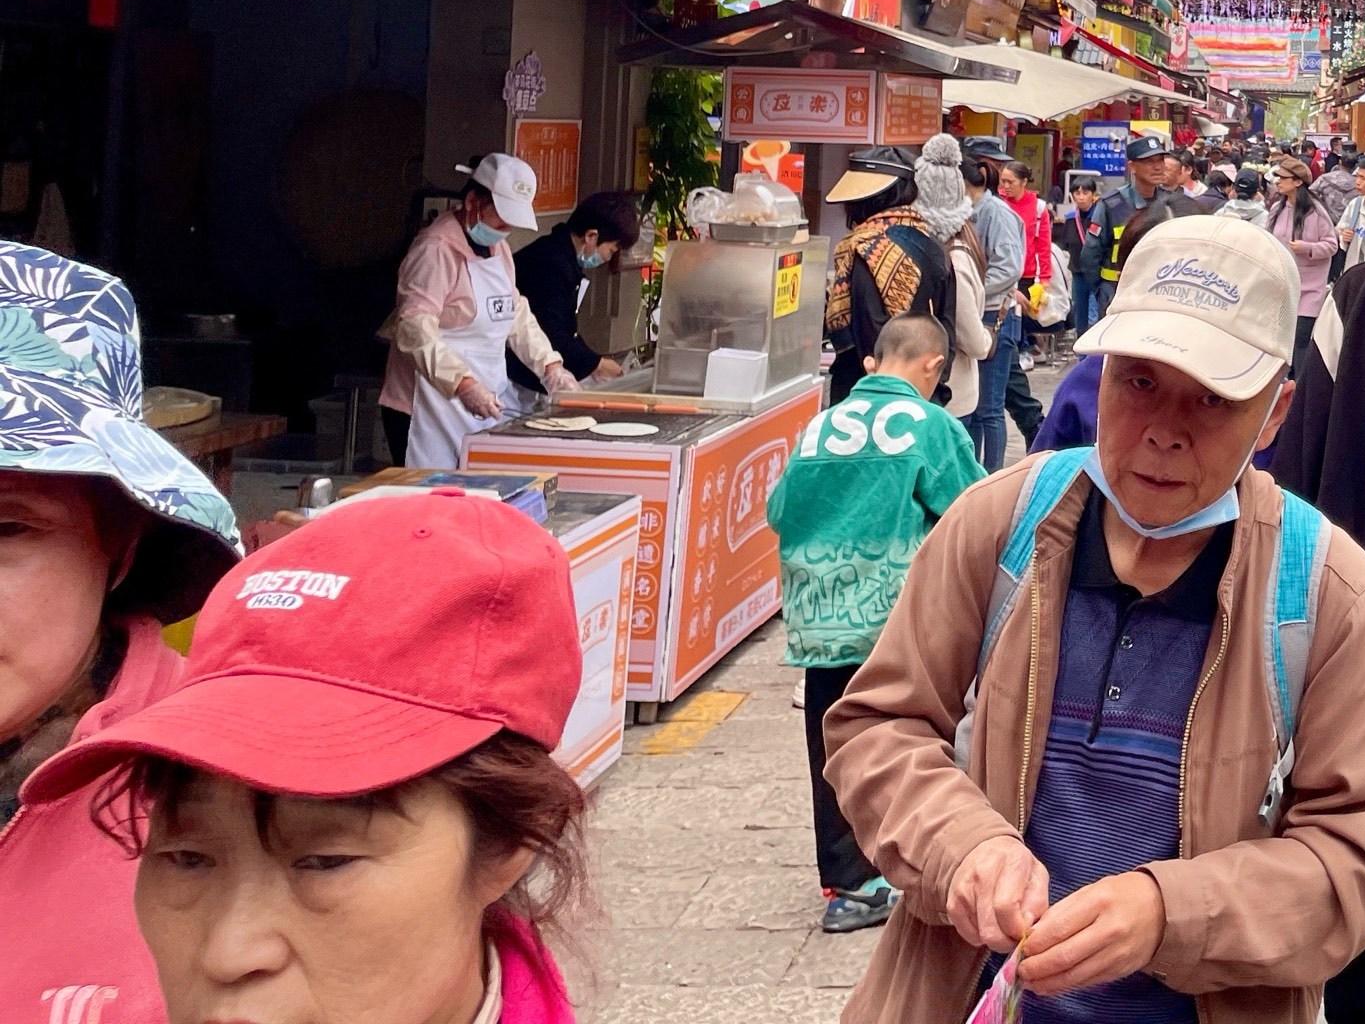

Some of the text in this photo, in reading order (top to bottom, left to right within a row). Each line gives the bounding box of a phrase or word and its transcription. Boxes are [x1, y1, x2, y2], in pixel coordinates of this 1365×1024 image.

[1156, 285, 1191, 301] UNION
[1195, 290, 1229, 312] MADE
[235, 569, 350, 601] BOSTON
